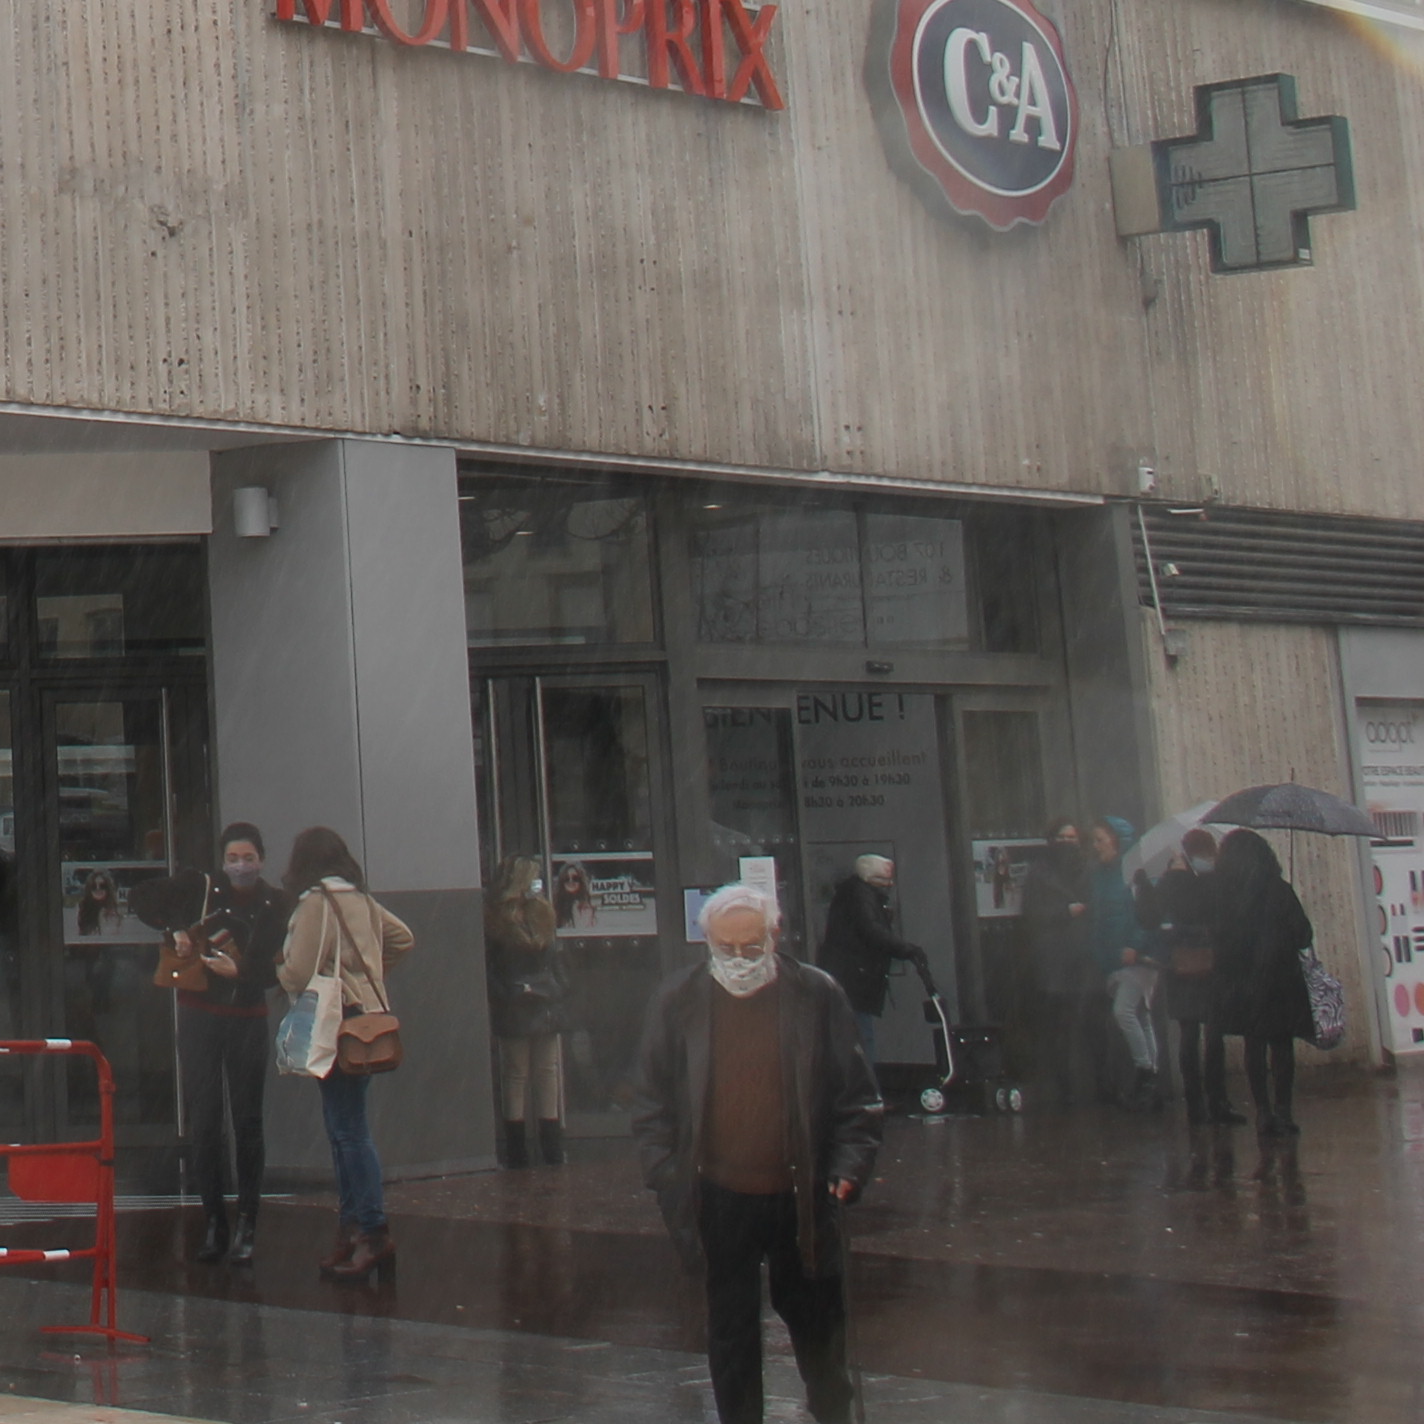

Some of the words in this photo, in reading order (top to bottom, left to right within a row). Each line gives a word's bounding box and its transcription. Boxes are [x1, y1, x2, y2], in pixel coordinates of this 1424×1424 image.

[944, 27, 1062, 153] C&A
[592, 881, 625, 892] HAPPY
[604, 893, 640, 905] SOLDES
